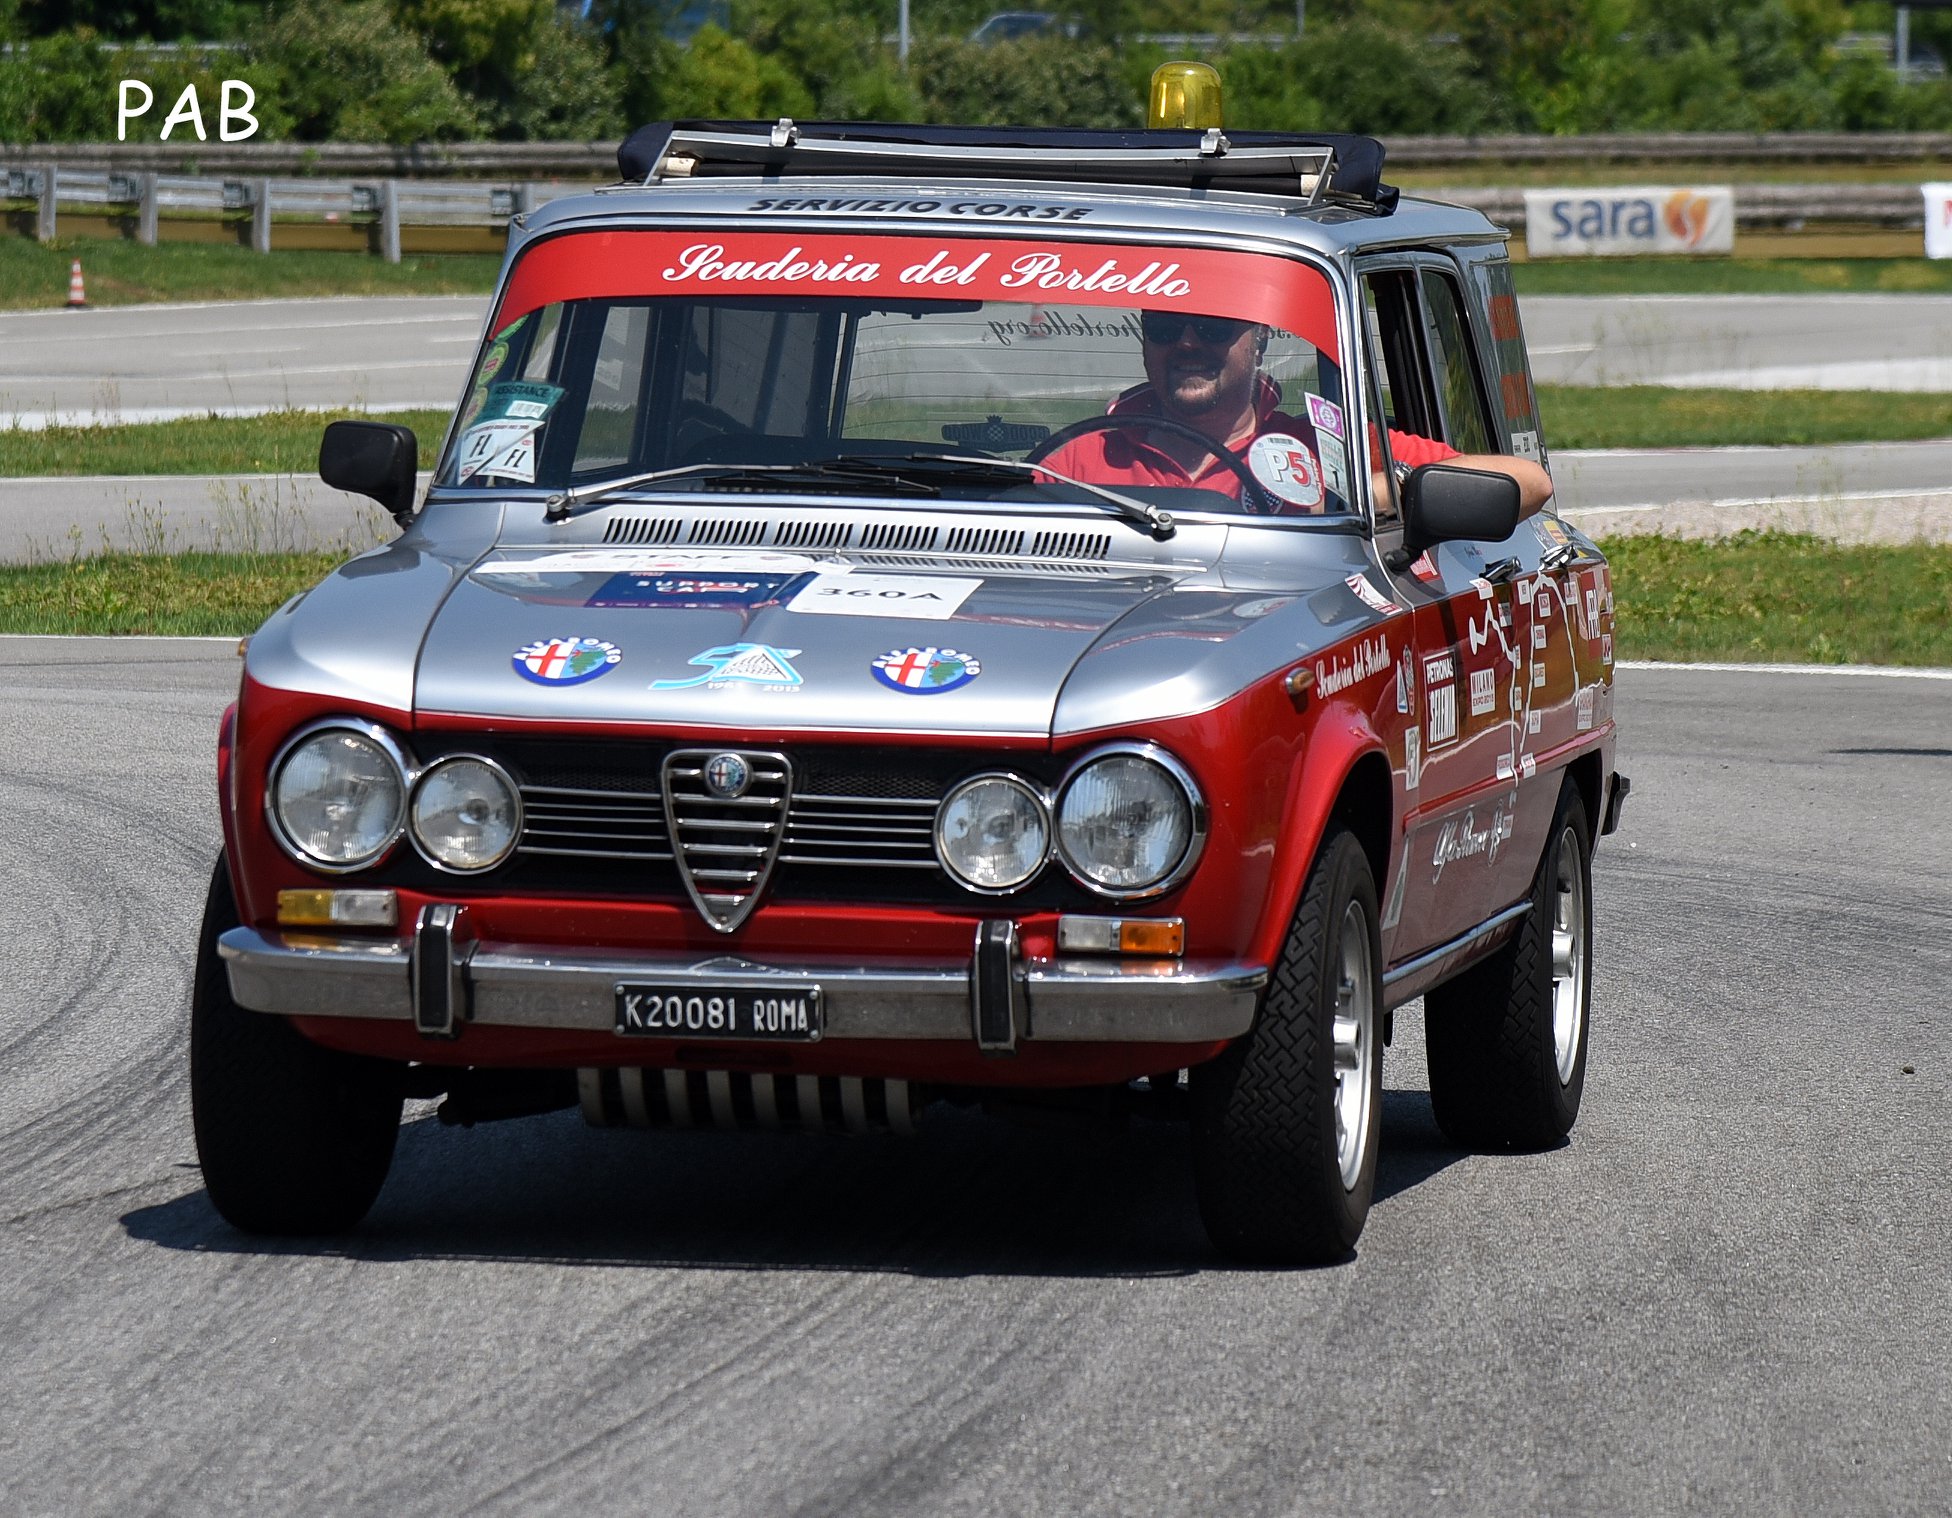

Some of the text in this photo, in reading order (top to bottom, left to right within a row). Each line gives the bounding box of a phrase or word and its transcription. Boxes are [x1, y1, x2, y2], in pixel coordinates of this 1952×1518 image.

[748, 198, 1095, 221] SERVIZIO CORSE
[1552, 199, 1655, 240] sara
[662, 243, 1192, 297] Scuderia del Portello
[1263, 448, 1311, 487] P5
[816, 587, 943, 601] 360A
[1426, 657, 1454, 685] PETRONAS
[1471, 671, 1494, 694] MILANO
[625, 994, 809, 1032] K20081 ROMA
